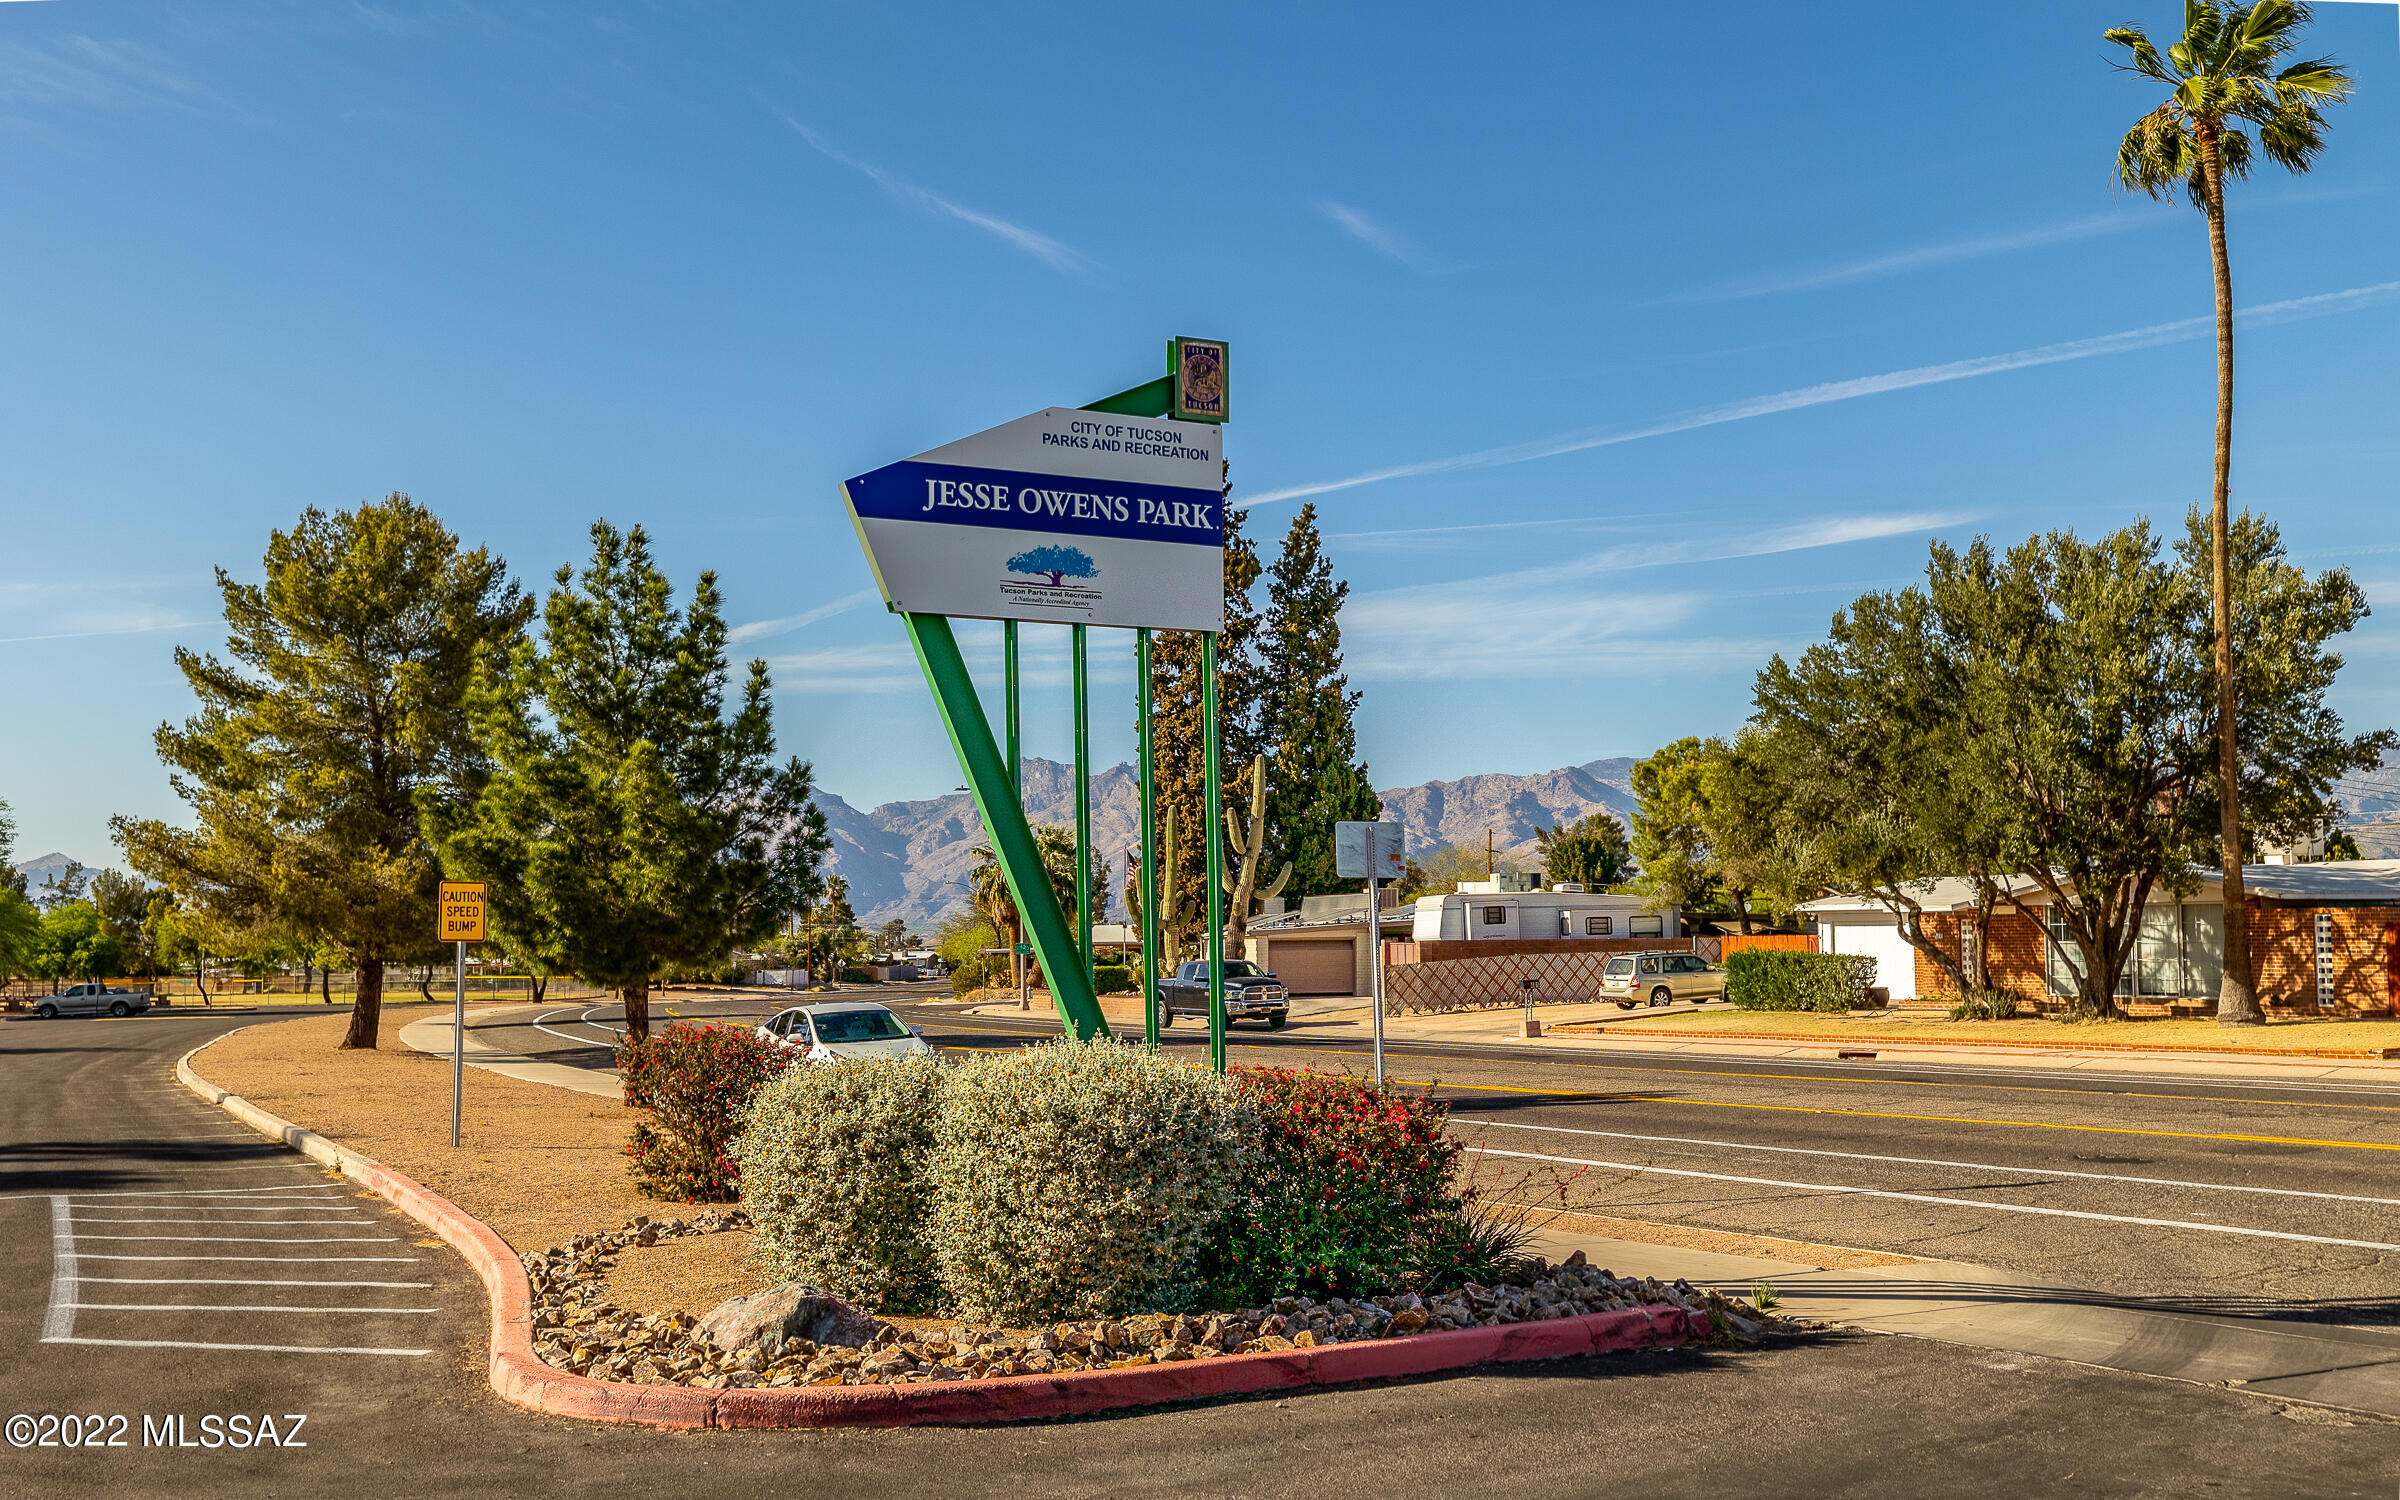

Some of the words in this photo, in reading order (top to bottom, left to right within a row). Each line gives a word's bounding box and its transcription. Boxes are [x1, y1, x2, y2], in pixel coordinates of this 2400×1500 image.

[1188, 400, 1219, 410] TUCSON
[1071, 421, 1101, 435] CITY
[1105, 425, 1123, 437] OF
[1127, 427, 1182, 444] TUCSON
[1042, 432, 1089, 449] PARKS
[1092, 438, 1120, 452] AND
[1125, 442, 1209, 461] RECREATION
[922, 479, 1010, 512] JESSE
[1018, 488, 1129, 521] OWENS
[1064, 592, 1103, 600] Recreation
[442, 891, 484, 903] CAUTION
[446, 906, 479, 917] SPEED
[448, 920, 477, 932] BUMP
